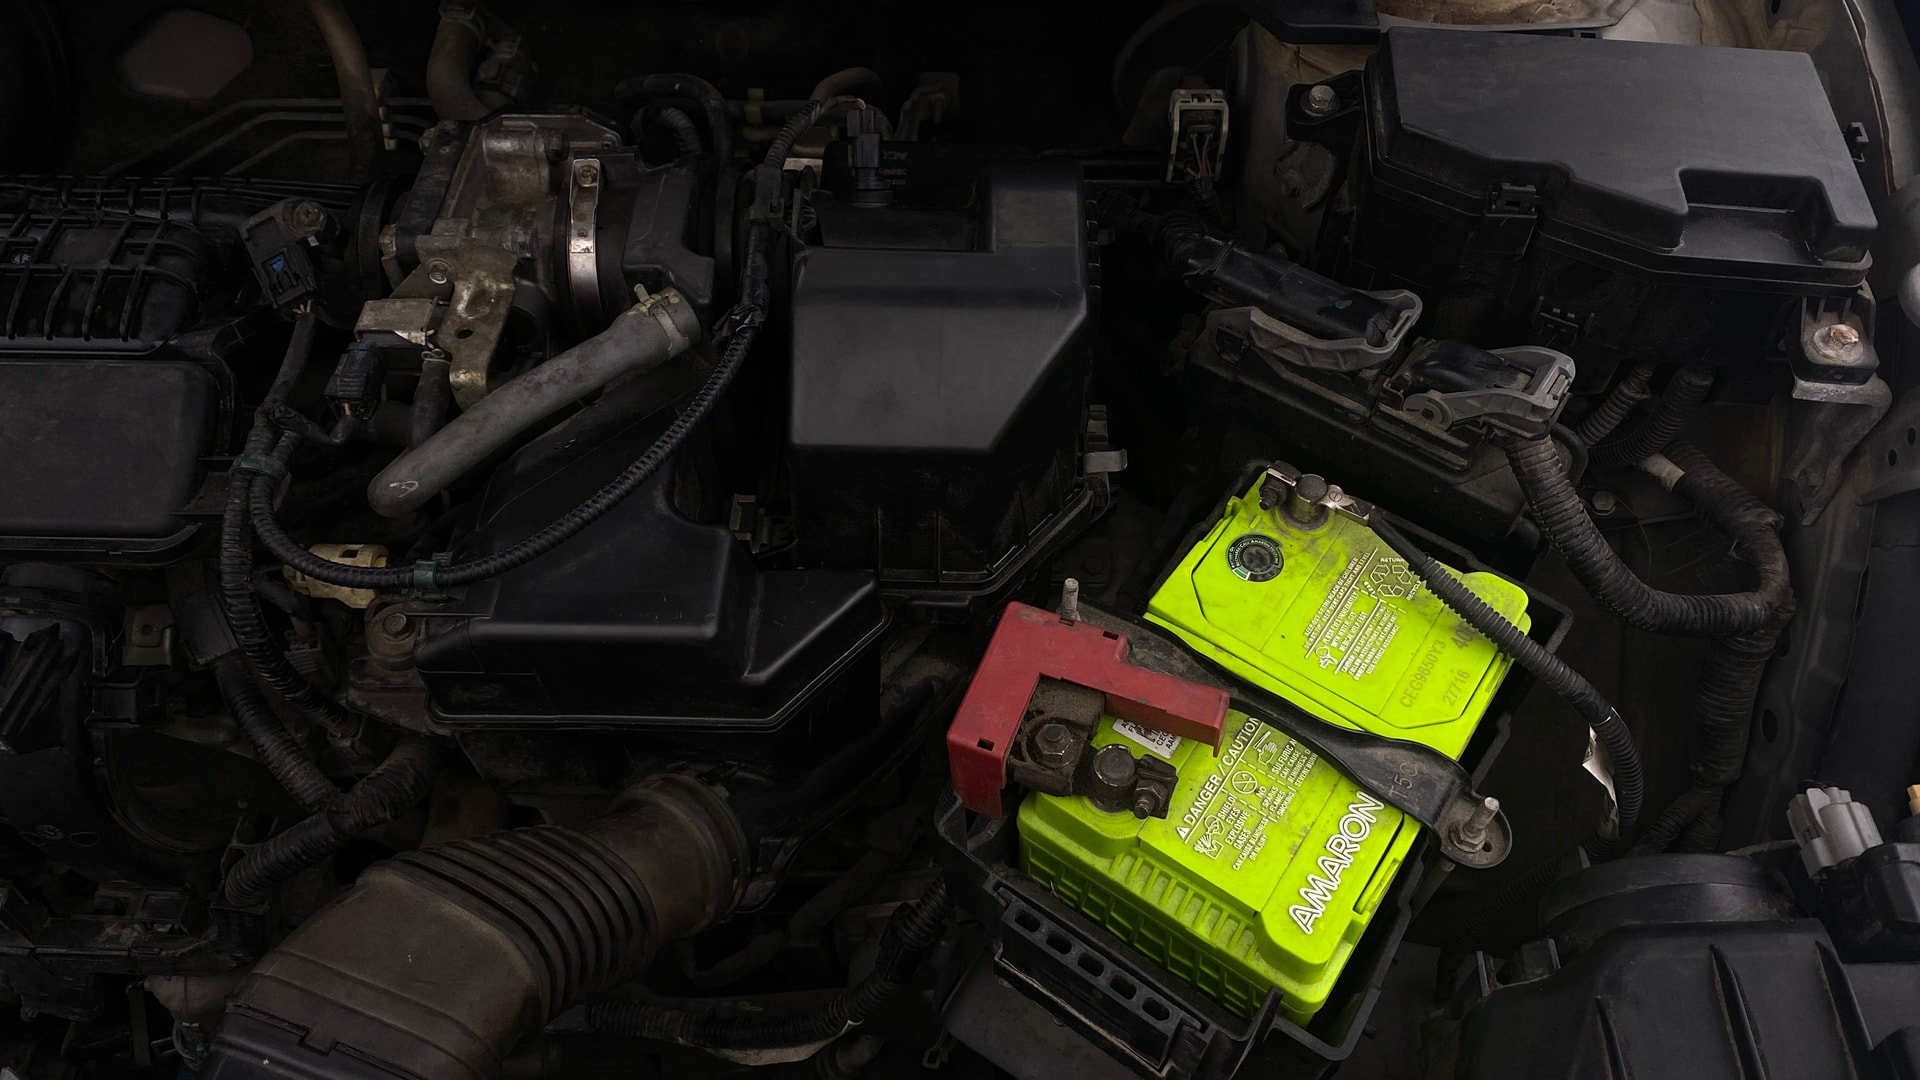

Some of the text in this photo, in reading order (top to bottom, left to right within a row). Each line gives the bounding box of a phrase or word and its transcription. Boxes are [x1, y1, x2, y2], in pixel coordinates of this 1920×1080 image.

[1271, 745, 1294, 774] SULFURIC
[1280, 767, 1291, 779] CAN
[1288, 750, 1302, 767] CAUSE
[1295, 767, 1310, 787] SEVERE
[1184, 774, 1223, 825] DANGER
[1256, 786, 1267, 797] NO
[1262, 786, 1280, 808] SPARKS
[1270, 791, 1287, 812] FLAMES
[1217, 796, 1237, 819] SHIELD
[1226, 807, 1241, 824] EYES
[1277, 792, 1296, 817] SMOKING
[1225, 811, 1251, 844] EXPLOSIVE
[1234, 828, 1251, 849] GASES
[1254, 834, 1270, 853] INJURY
[1233, 859, 1244, 870] CAN
[1240, 843, 1254, 860] CAUSE
[1288, 791, 1385, 935] AMARON
